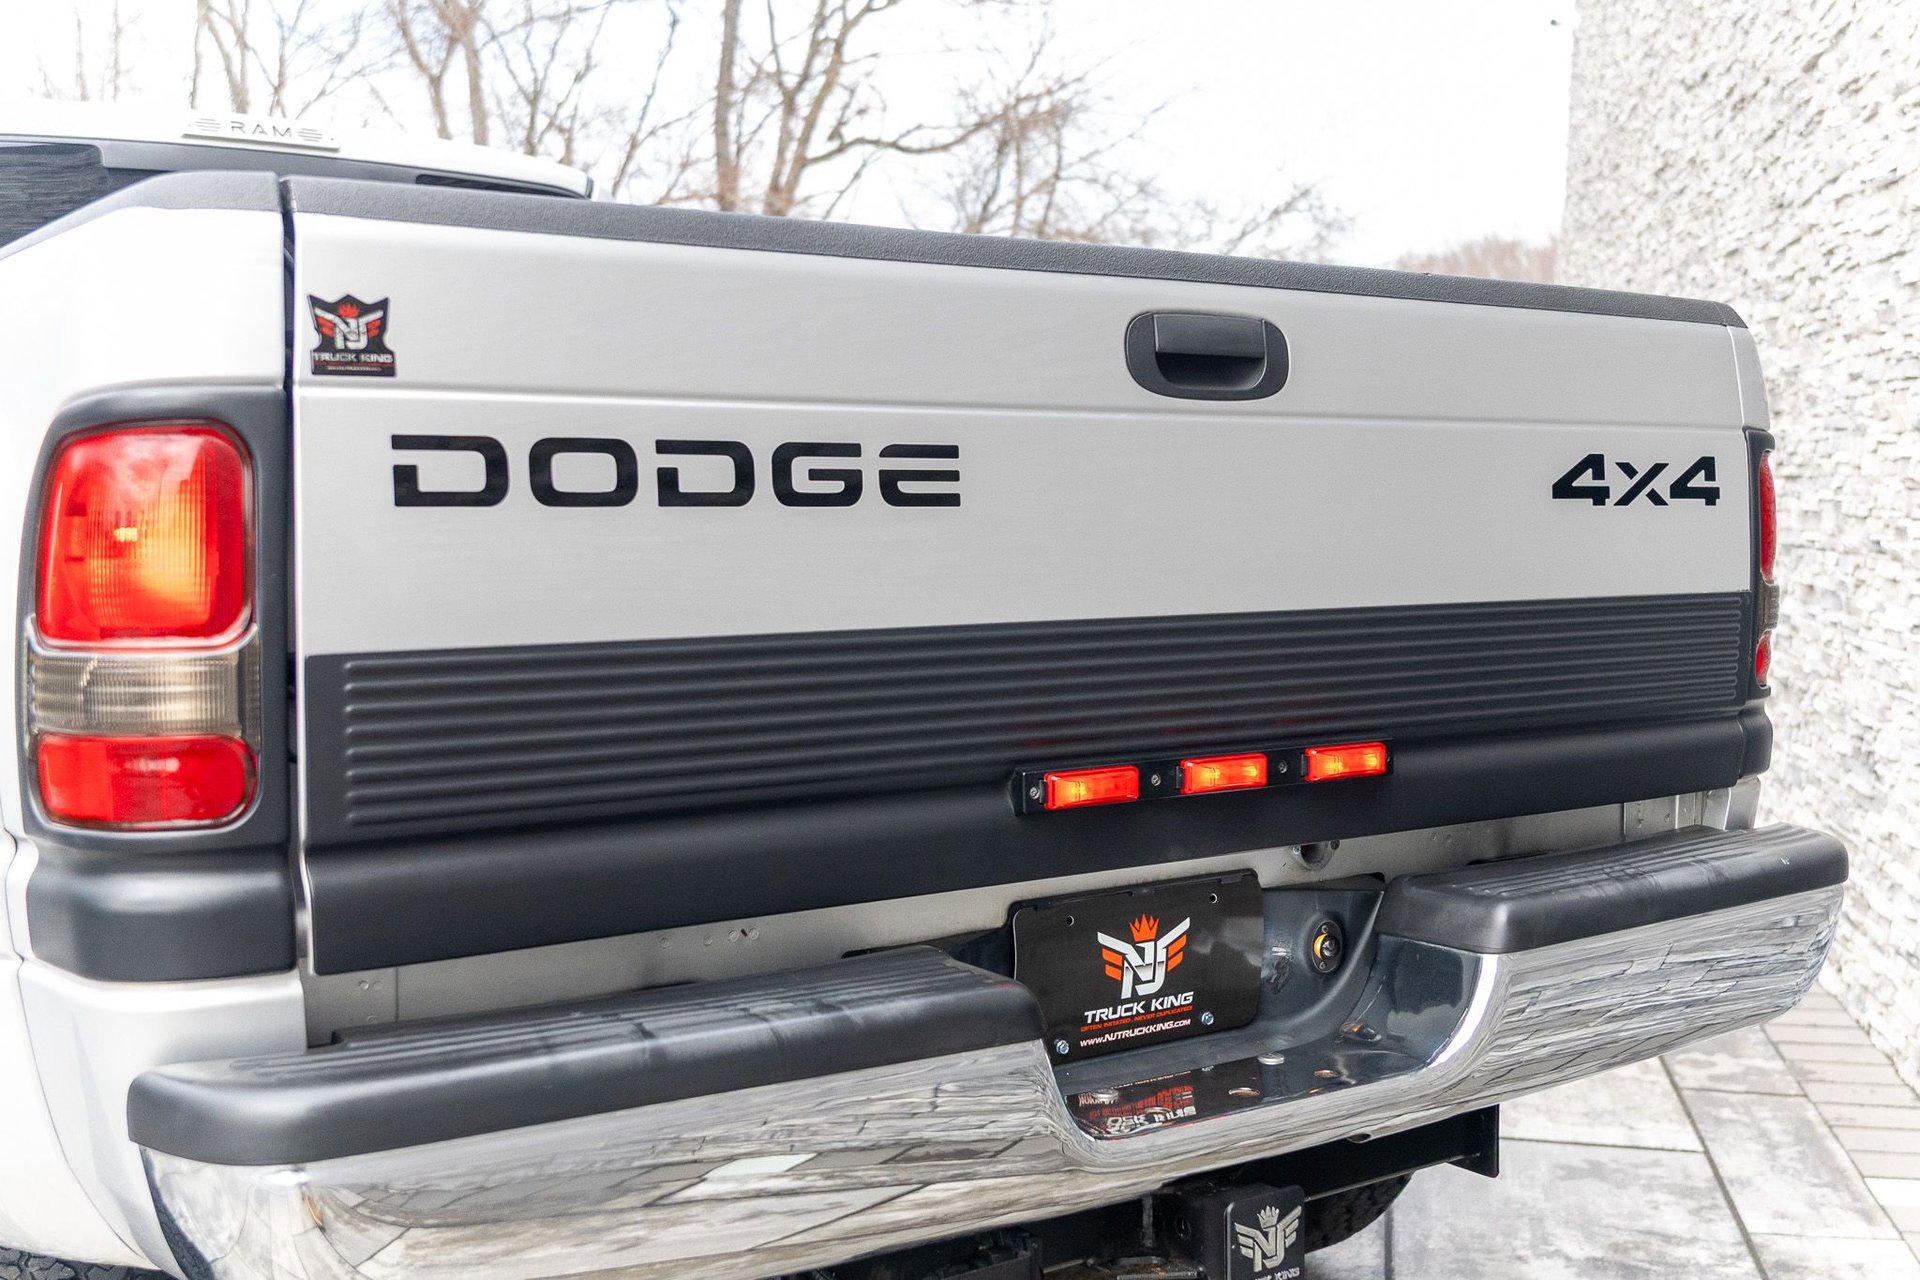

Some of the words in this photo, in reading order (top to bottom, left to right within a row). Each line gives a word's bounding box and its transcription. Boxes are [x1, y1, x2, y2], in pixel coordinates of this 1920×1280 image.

[230, 120, 292, 138] RAM
[314, 352, 358, 361] TRUCK
[361, 354, 393, 363] KING
[391, 434, 961, 508] DODGE
[1084, 1000, 1146, 1024] TRUCK
[1150, 991, 1194, 1012] KING
[1081, 1023, 1103, 1032] OFTEN
